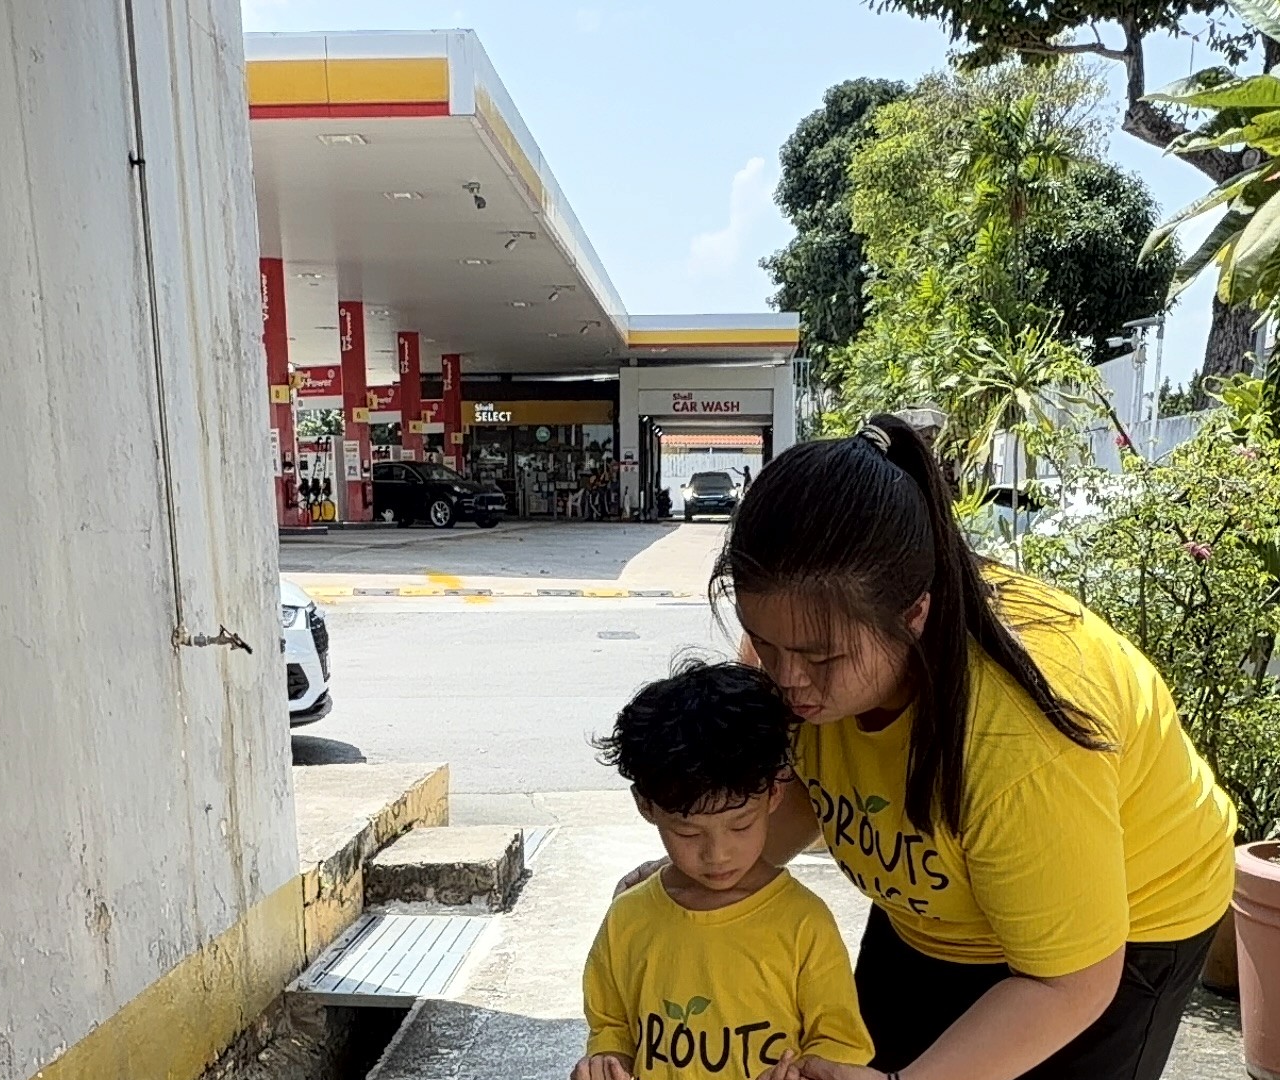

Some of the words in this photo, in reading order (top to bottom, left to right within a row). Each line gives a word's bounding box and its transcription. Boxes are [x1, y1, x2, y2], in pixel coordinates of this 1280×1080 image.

[673, 392, 693, 400] Shell
[672, 401, 698, 412] CAR
[701, 401, 740, 412] WASH
[474, 411, 512, 422] SELECT
